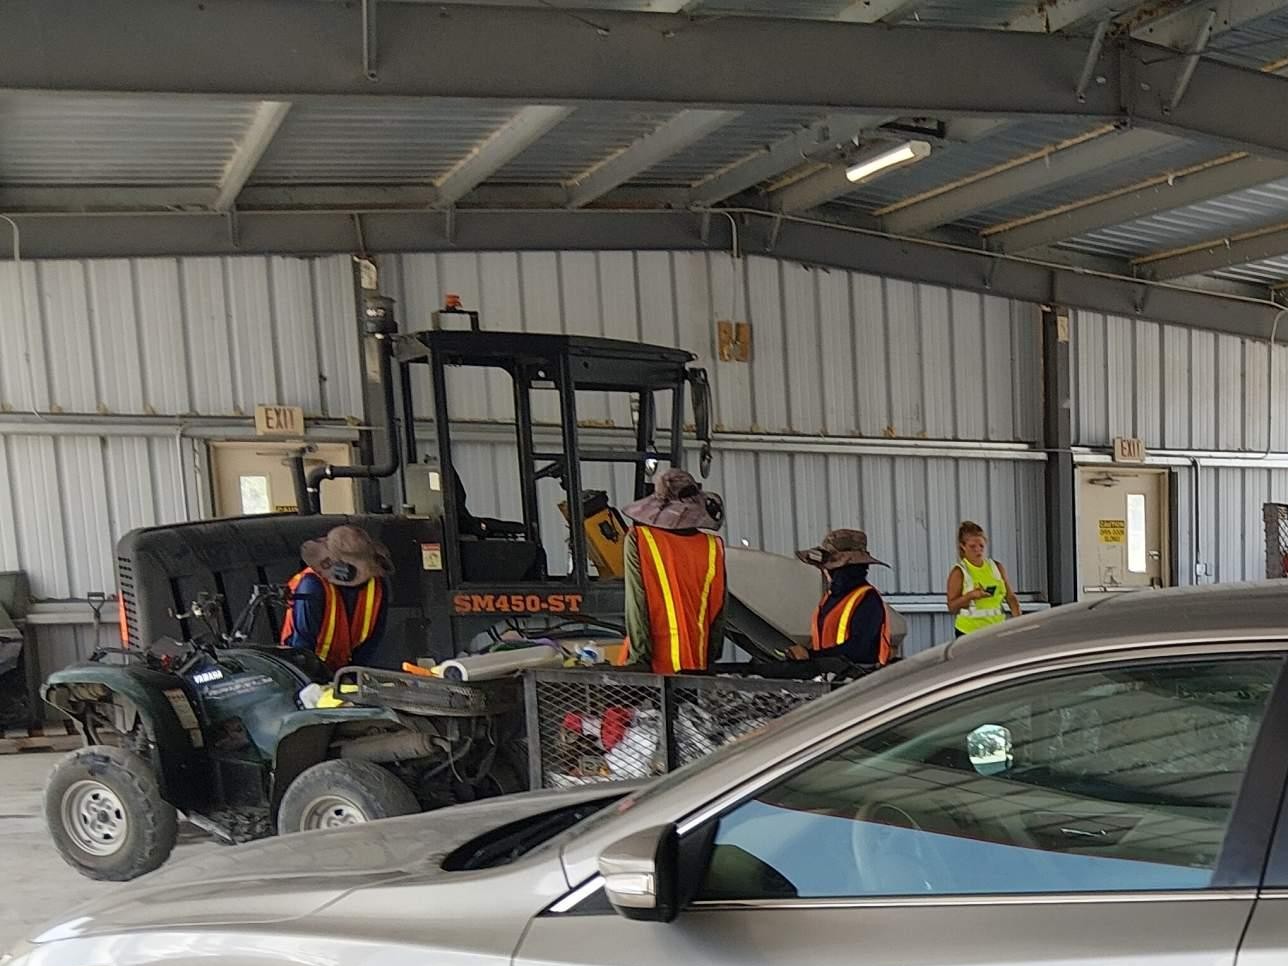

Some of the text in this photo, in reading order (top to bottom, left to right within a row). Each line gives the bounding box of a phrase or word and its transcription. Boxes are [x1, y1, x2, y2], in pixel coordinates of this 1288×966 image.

[264, 407, 295, 430] EXIT
[1120, 439, 1142, 458] EXIT
[453, 593, 583, 614] SM450-ST
[192, 669, 224, 684] YAMAHA
